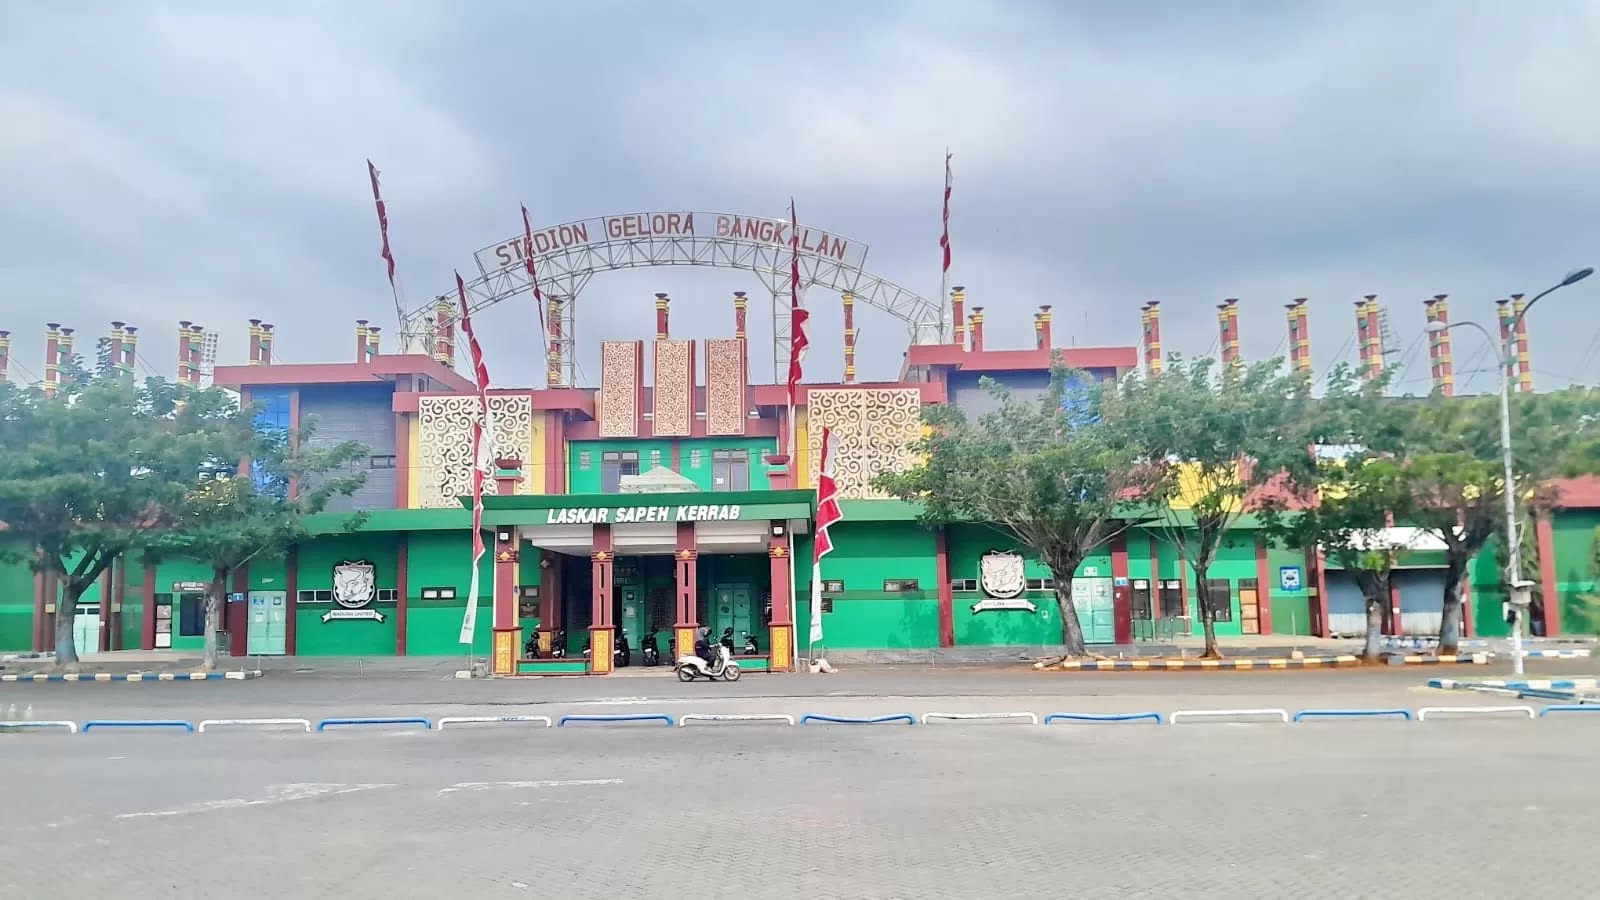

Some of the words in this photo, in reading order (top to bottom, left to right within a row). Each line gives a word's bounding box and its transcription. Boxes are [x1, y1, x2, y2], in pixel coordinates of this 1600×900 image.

[495, 222, 588, 267] STADION
[608, 213, 694, 238] GELORA
[546, 507, 609, 524] LASKAR
[615, 506, 670, 523] SAPEH
[676, 504, 741, 521] KERRAB
